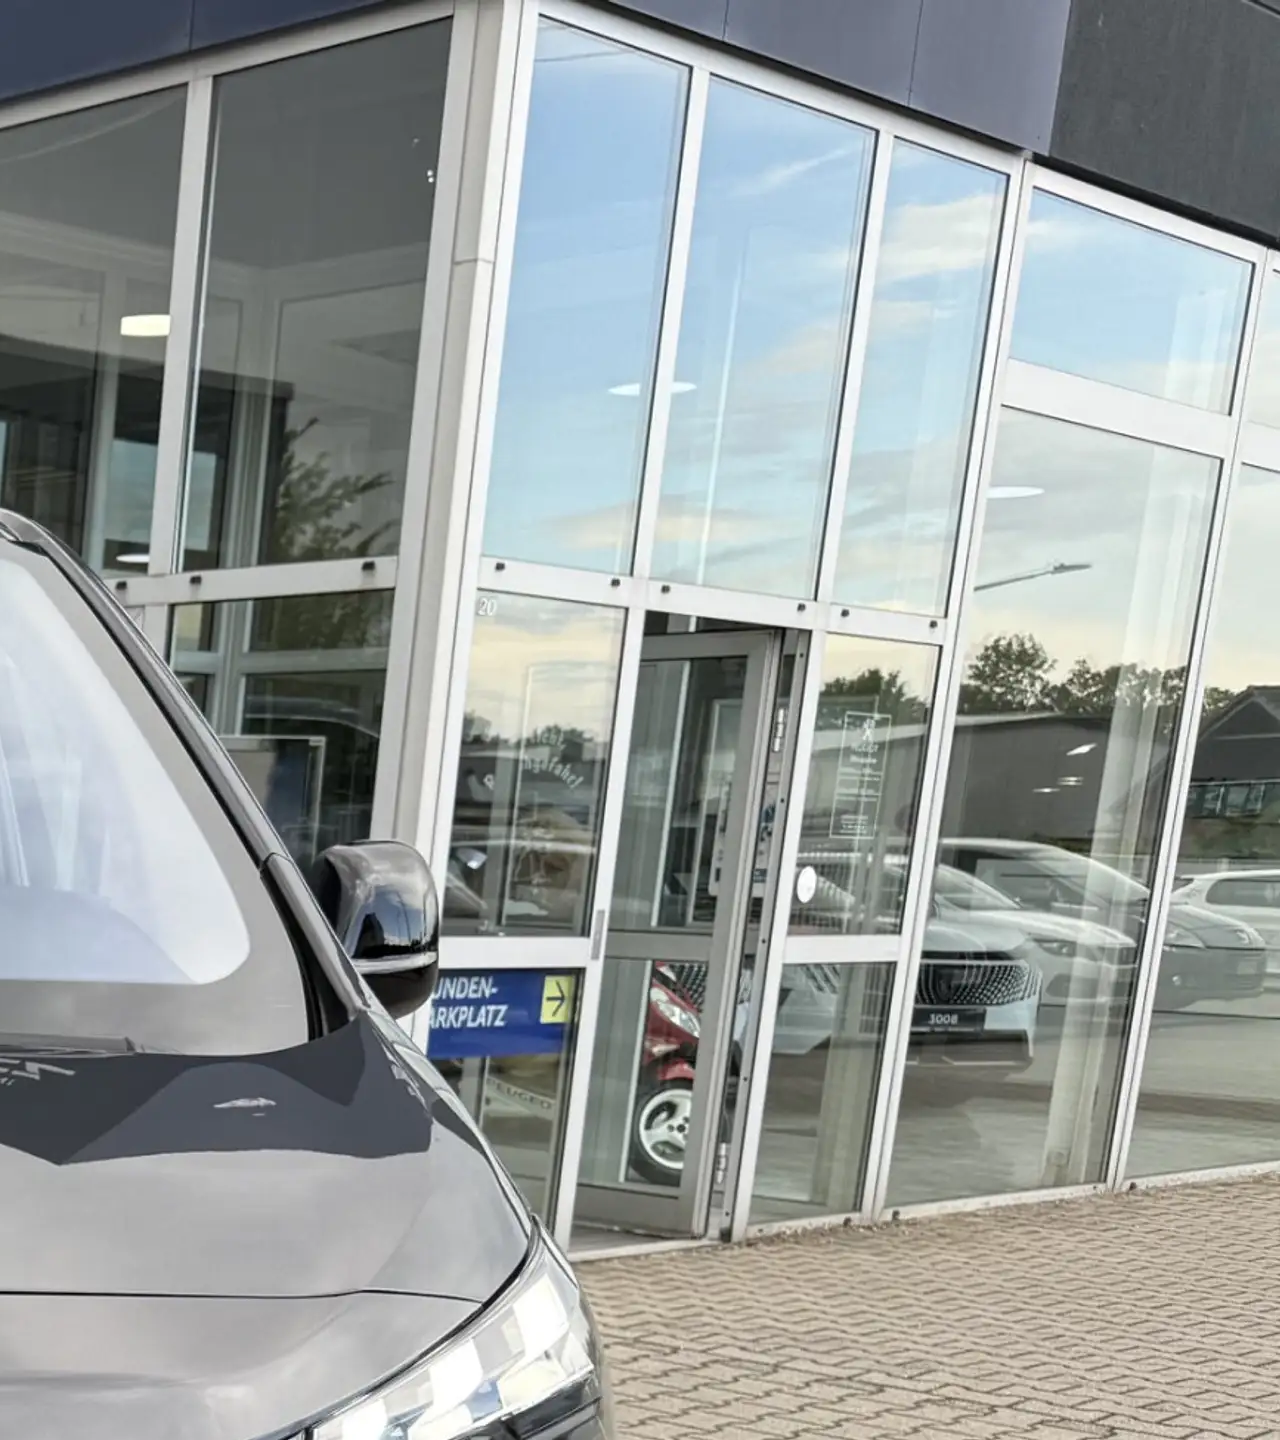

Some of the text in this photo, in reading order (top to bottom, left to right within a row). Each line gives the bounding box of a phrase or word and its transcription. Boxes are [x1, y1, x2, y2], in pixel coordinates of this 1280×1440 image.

[477, 597, 498, 616] 20
[432, 976, 499, 1000] UNDEN-
[428, 1003, 510, 1030] ARKPLATZ
